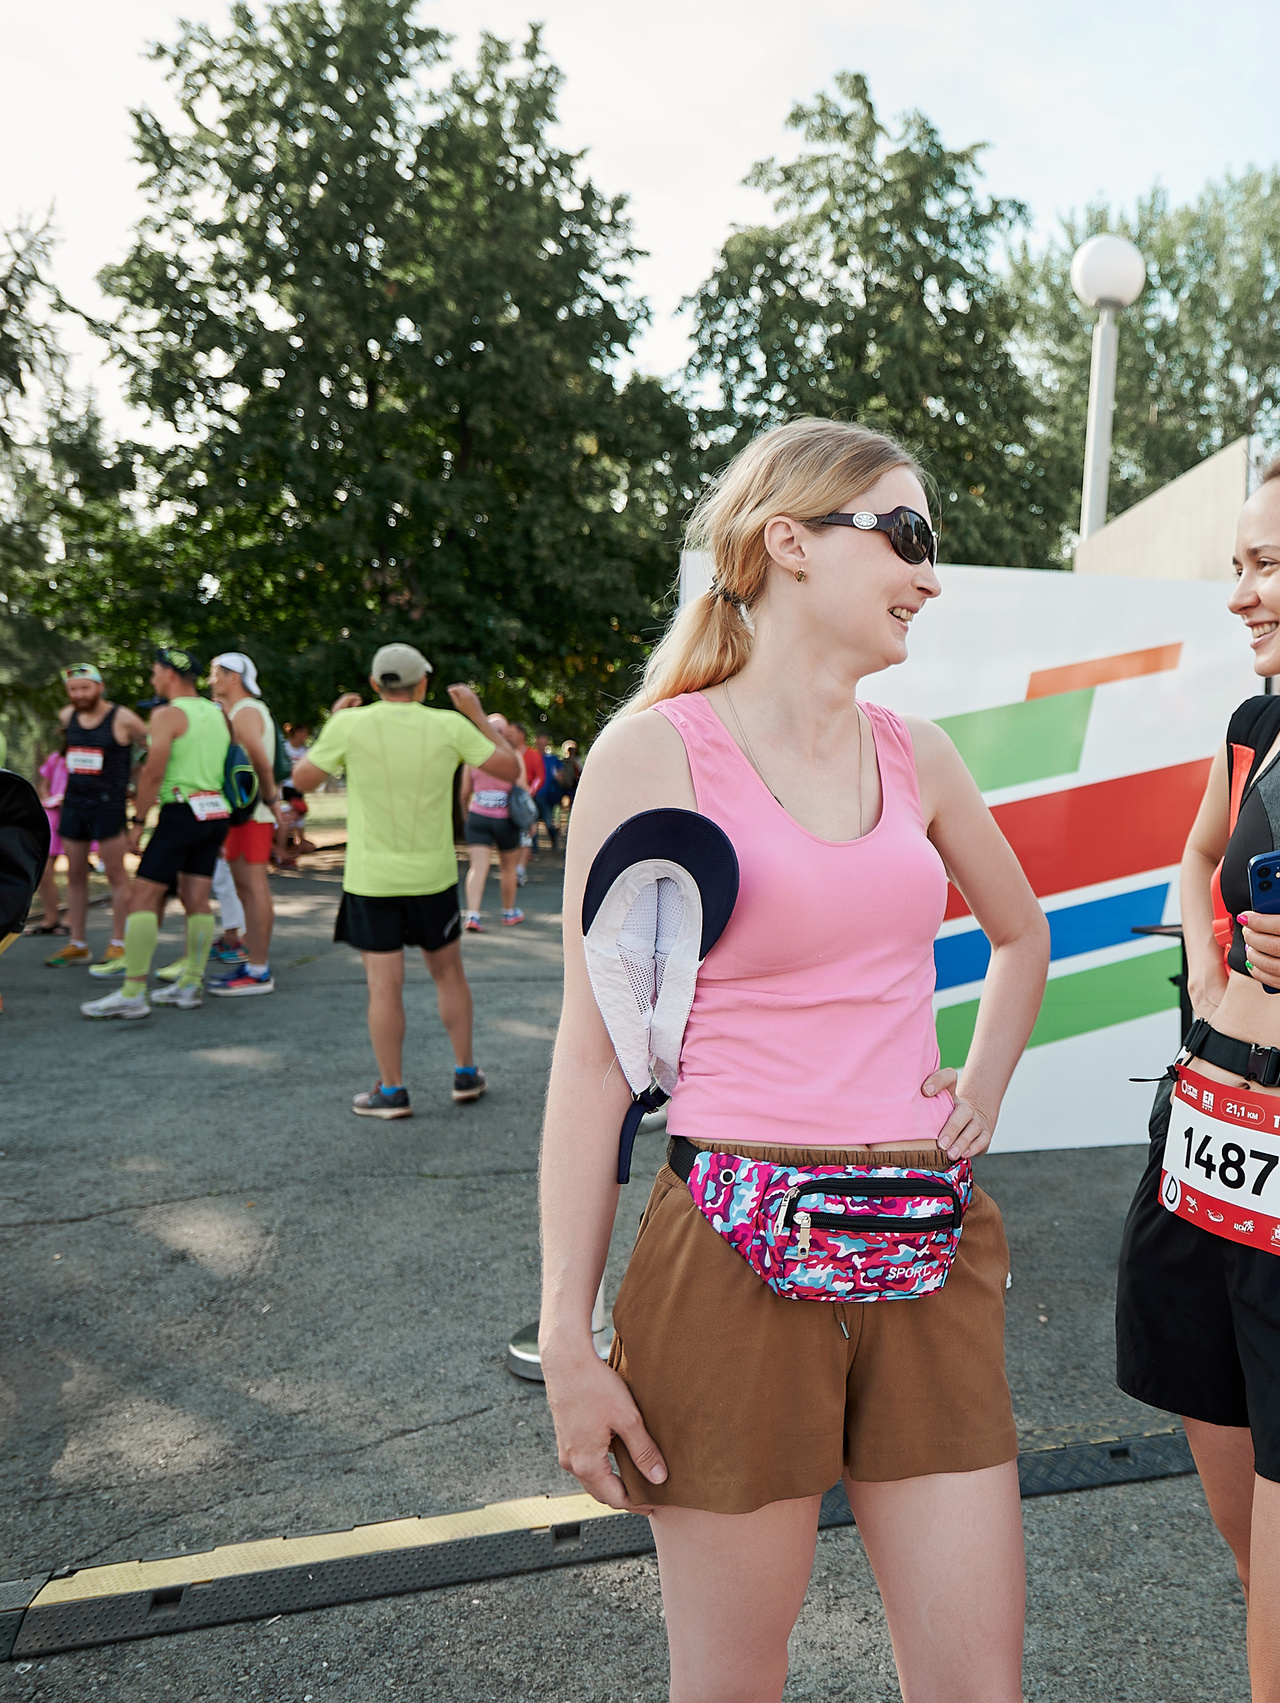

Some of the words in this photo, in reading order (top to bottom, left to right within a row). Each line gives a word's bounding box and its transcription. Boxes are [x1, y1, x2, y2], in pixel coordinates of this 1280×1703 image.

[1225, 1102, 1247, 1118] 21,1
[1184, 1126, 1279, 1196] 1487
[888, 1265, 931, 1279] SPORT
